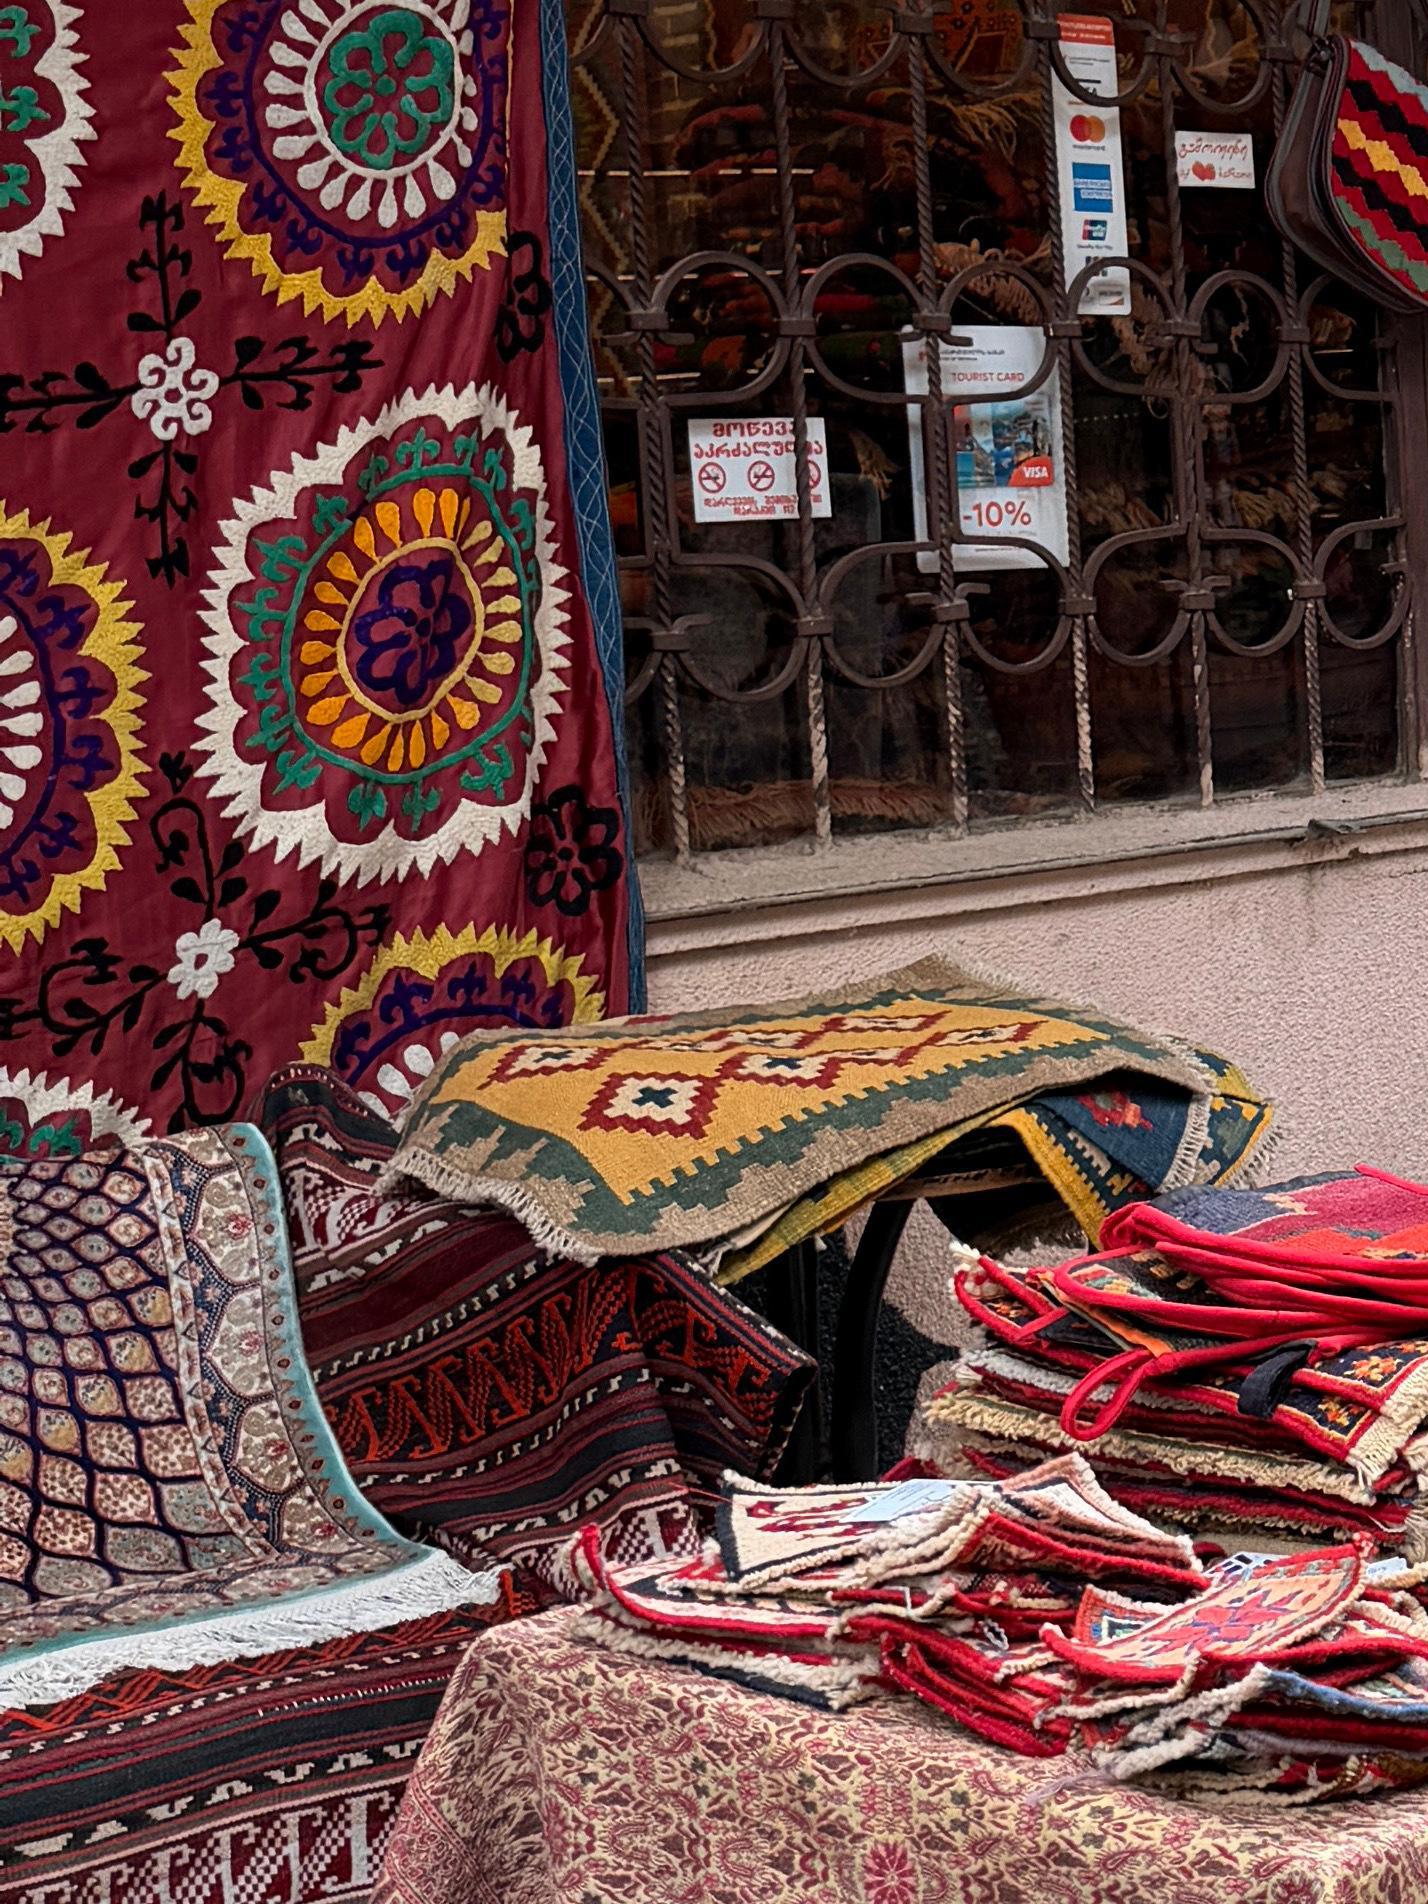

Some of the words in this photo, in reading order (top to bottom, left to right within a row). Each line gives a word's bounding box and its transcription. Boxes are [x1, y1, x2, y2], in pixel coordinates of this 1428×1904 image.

[951, 371, 994, 383] TOURIST
[996, 371, 1026, 383] CARD
[1023, 466, 1048, 478] VISA
[962, 500, 1032, 527] -10%
